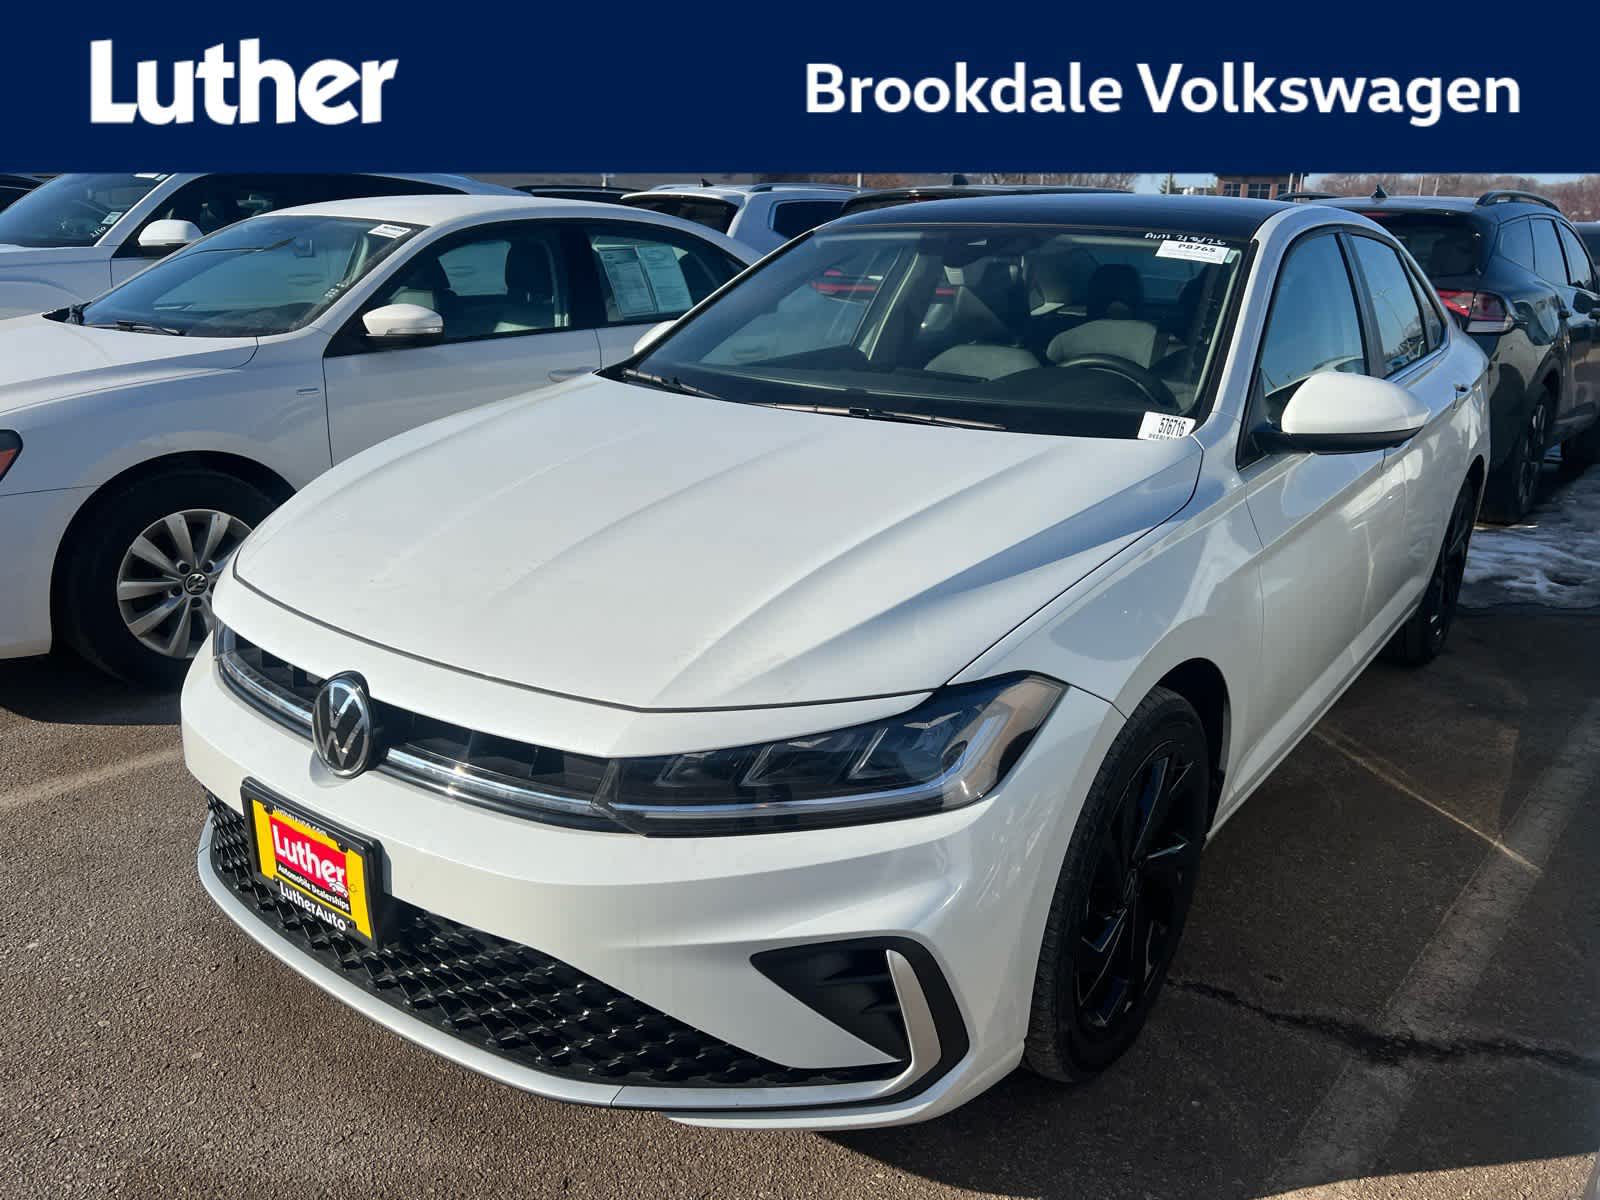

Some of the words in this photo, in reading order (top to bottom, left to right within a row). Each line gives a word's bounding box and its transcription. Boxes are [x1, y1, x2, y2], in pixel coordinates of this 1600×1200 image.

[1158, 416, 1187, 438] 576716
[272, 824, 346, 883] Luther
[279, 880, 347, 932] LutherAuto
[311, 883, 351, 912] Dealerships
